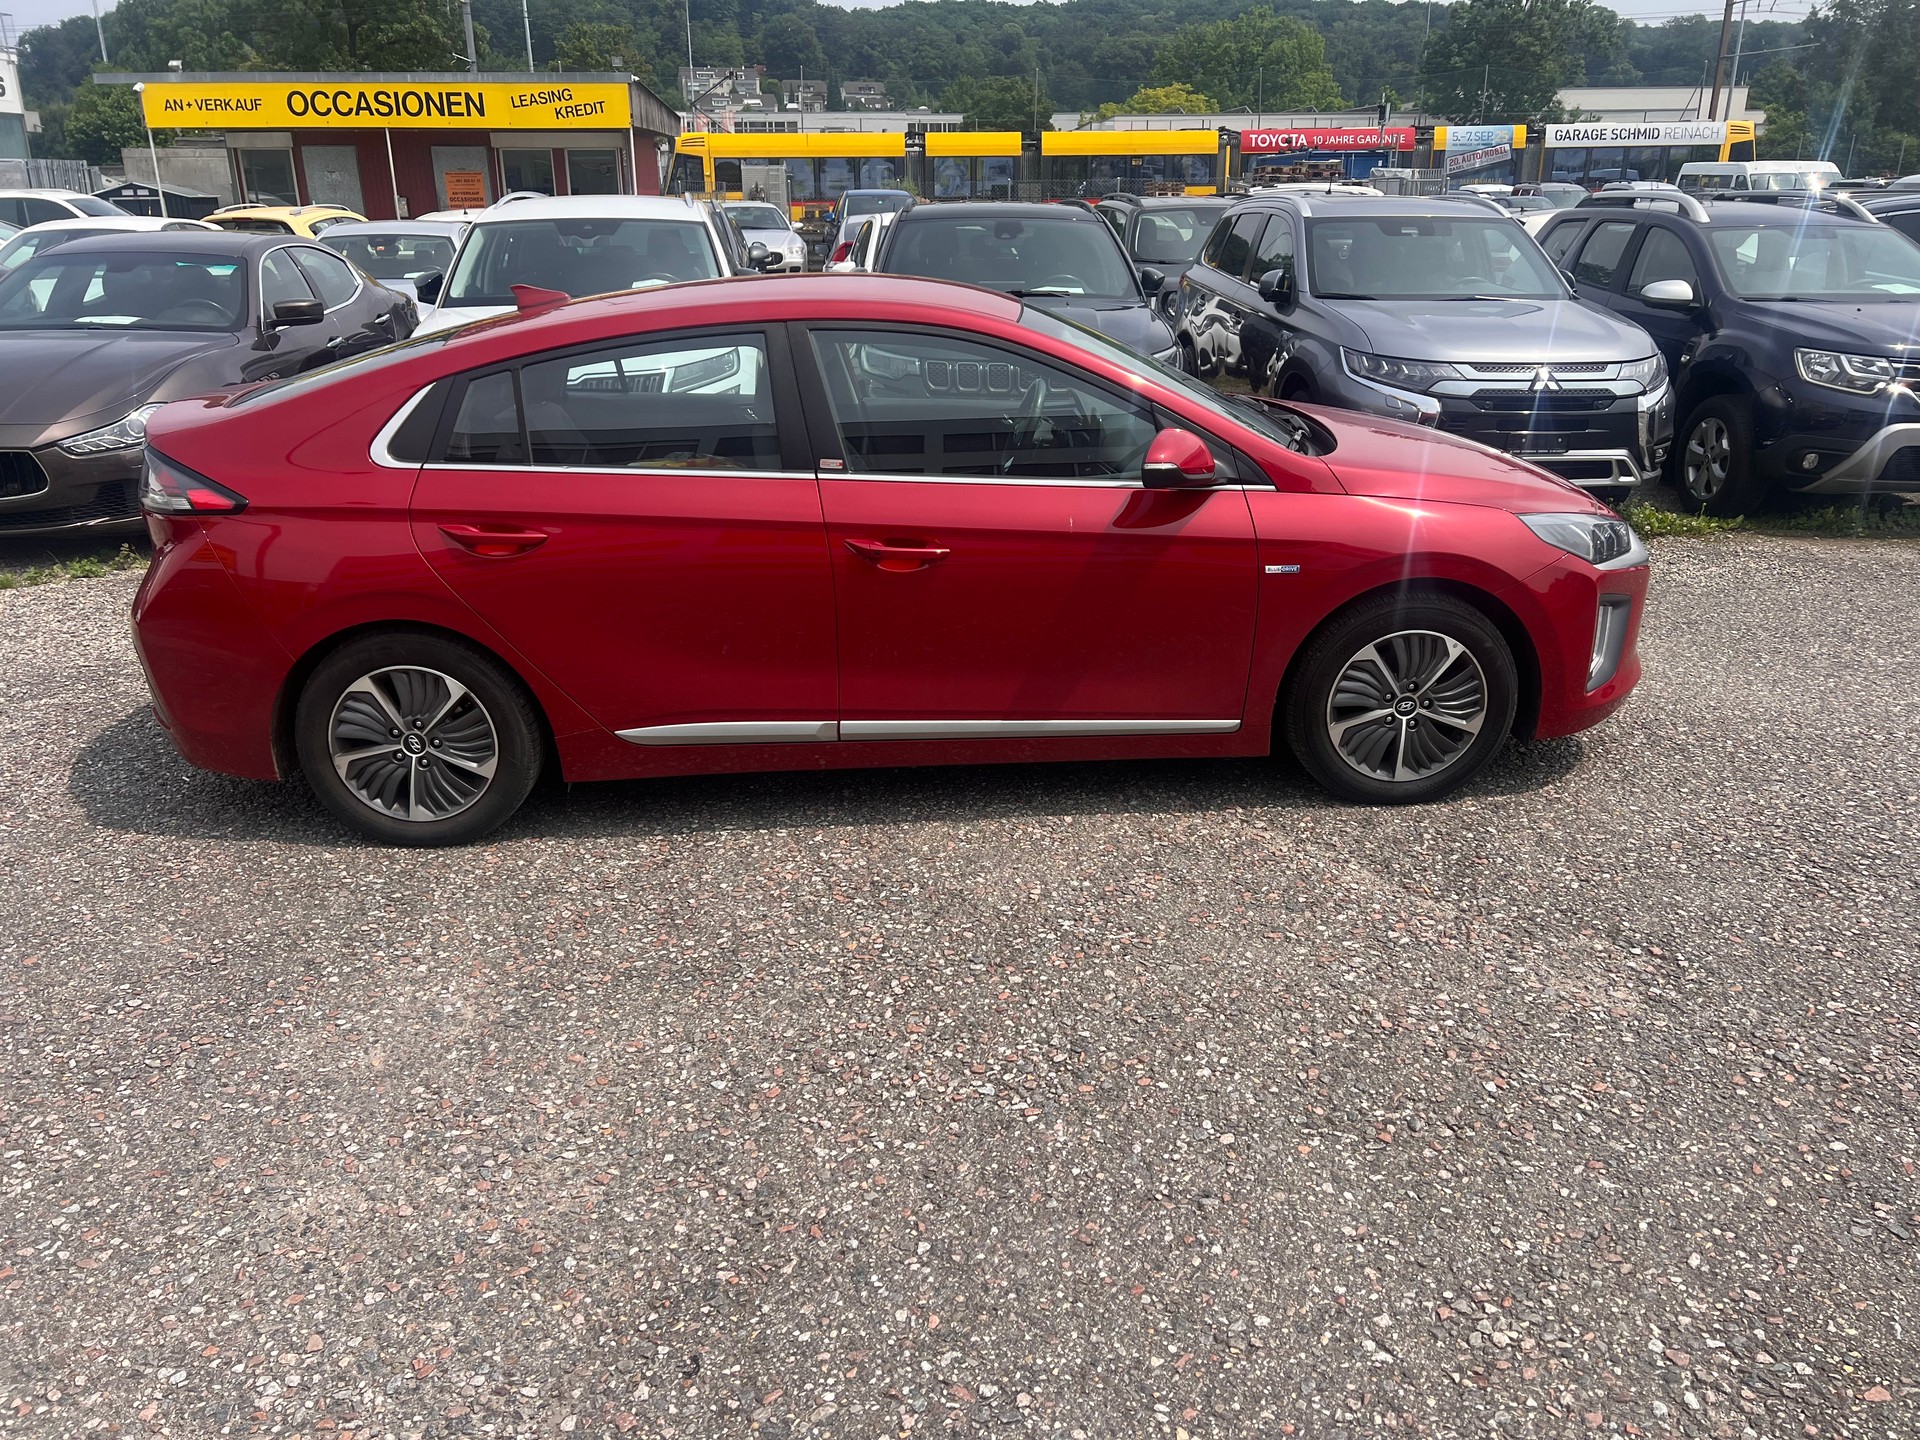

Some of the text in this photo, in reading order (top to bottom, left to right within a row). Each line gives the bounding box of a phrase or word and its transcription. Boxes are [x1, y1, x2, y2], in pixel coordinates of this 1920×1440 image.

[195, 98, 262, 111] VERKAUF
[286, 90, 486, 117] OCCASIONEN
[511, 88, 573, 109] LEASING
[555, 101, 605, 119] KREDIT
[1313, 135, 1323, 145] 10
[1325, 134, 1355, 145] JAHRE
[1357, 134, 1406, 144] GARANTE
[1495, 131, 1508, 141] 25
[1554, 126, 1720, 142] GARAGE SCHMID REINACH
[1461, 145, 1508, 164] AUTO/MOBIL
